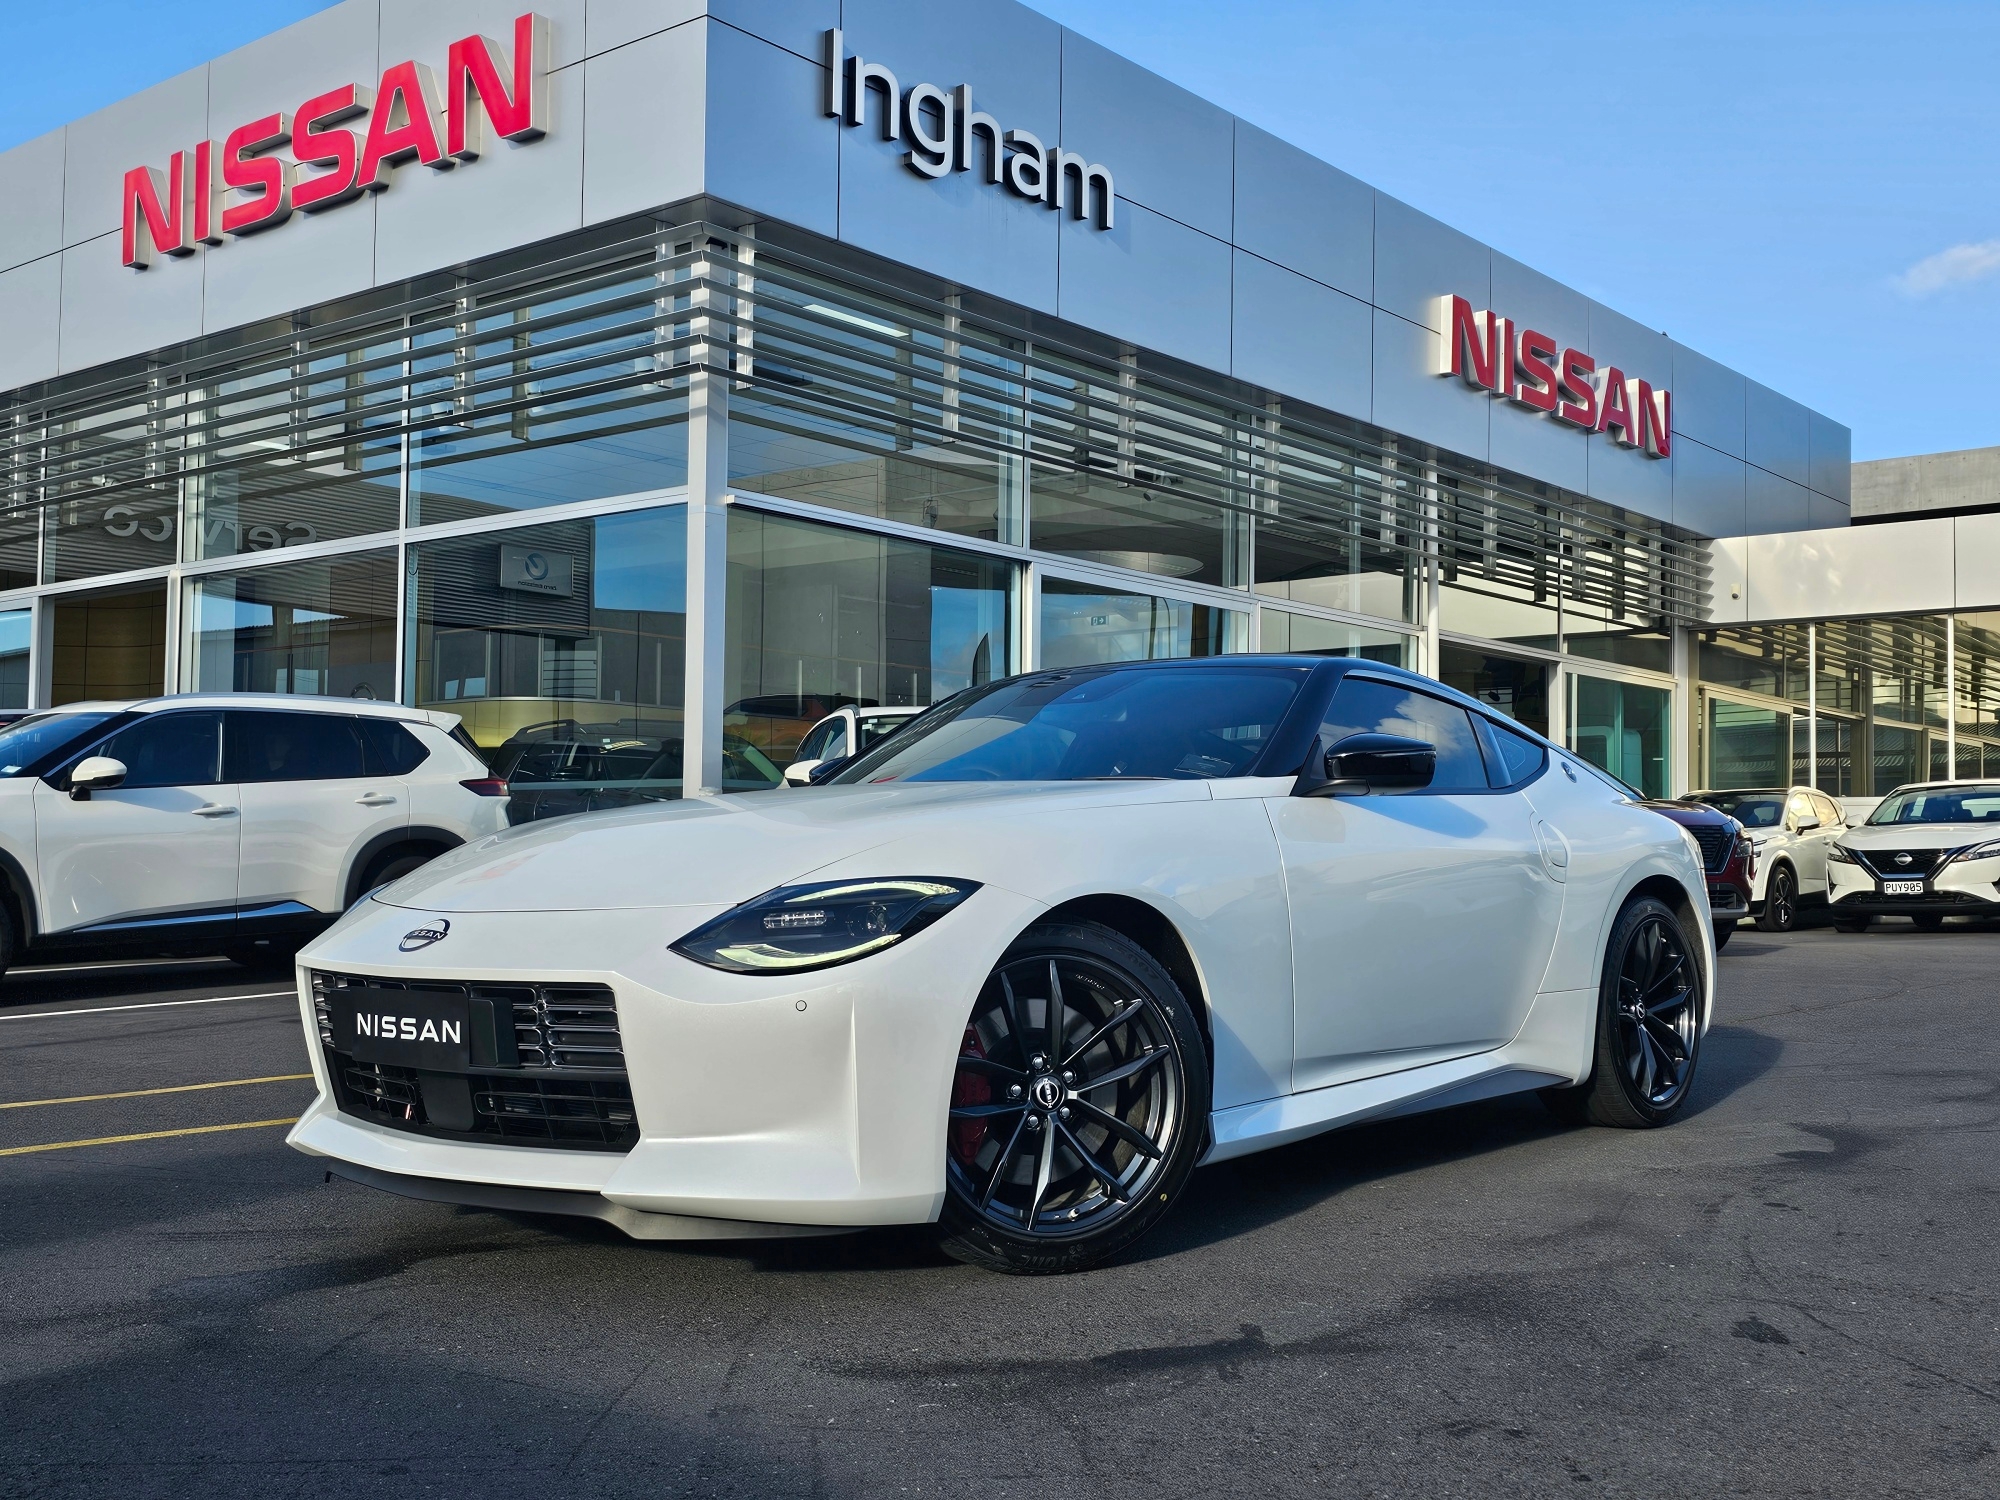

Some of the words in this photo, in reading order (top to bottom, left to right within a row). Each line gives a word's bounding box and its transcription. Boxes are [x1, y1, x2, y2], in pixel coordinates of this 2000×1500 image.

[122, 12, 548, 269] NISSAN
[823, 27, 1114, 230] Ingham
[1439, 293, 1671, 459] NISSAN
[1885, 882, 1922, 892] PUY905
[356, 1012, 461, 1044] NISSAN
